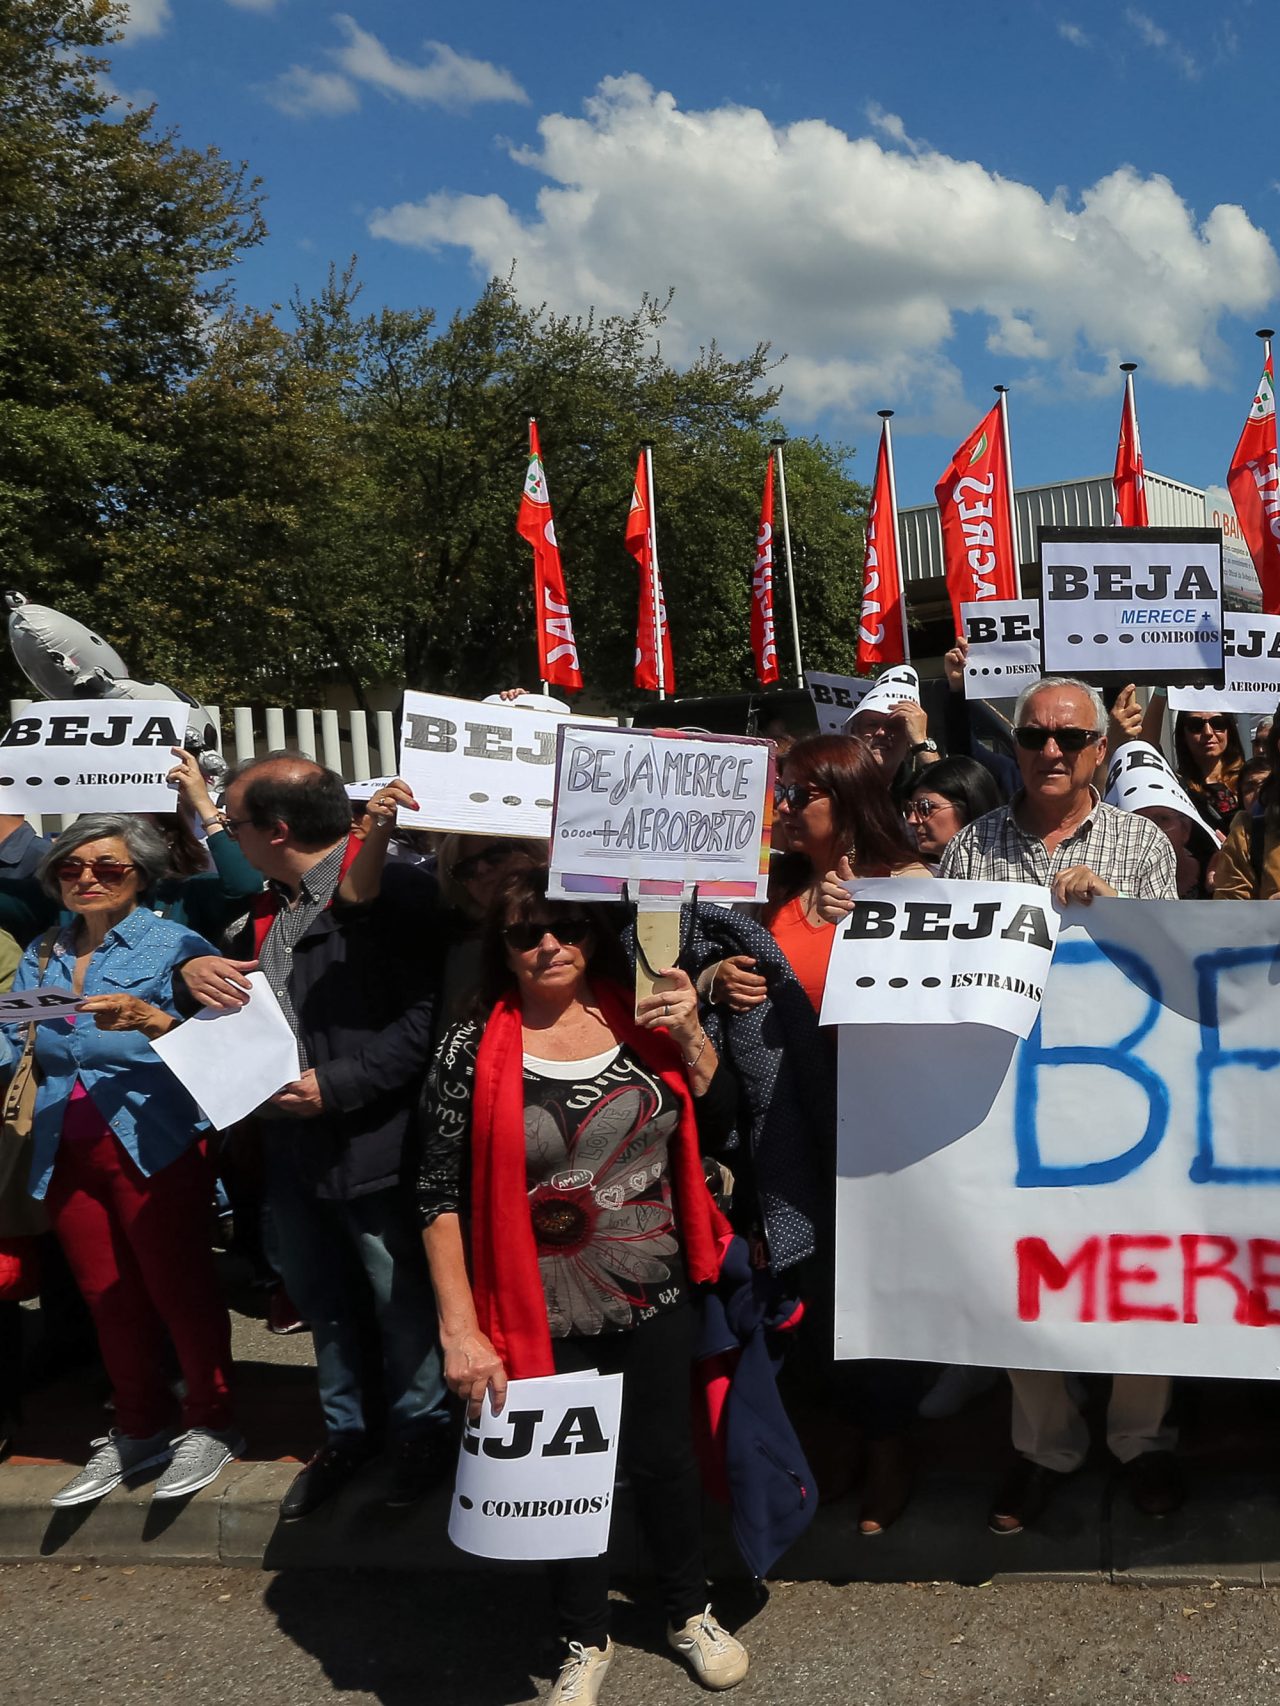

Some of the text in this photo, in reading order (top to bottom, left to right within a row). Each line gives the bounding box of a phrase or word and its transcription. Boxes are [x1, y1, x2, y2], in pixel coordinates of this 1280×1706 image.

[1047, 566, 1218, 601] BEJA
[1120, 609, 1212, 625] MERECE +
[1140, 630, 1219, 645] COMBOIOS
[0, 716, 182, 748] BEJA
[75, 772, 168, 787] AEROPORT
[661, 750, 753, 800] MERECE
[842, 900, 1054, 951] BEJA
[950, 972, 1043, 1003] ESTRADAS
[482, 1496, 602, 1518] COMBOIOS
